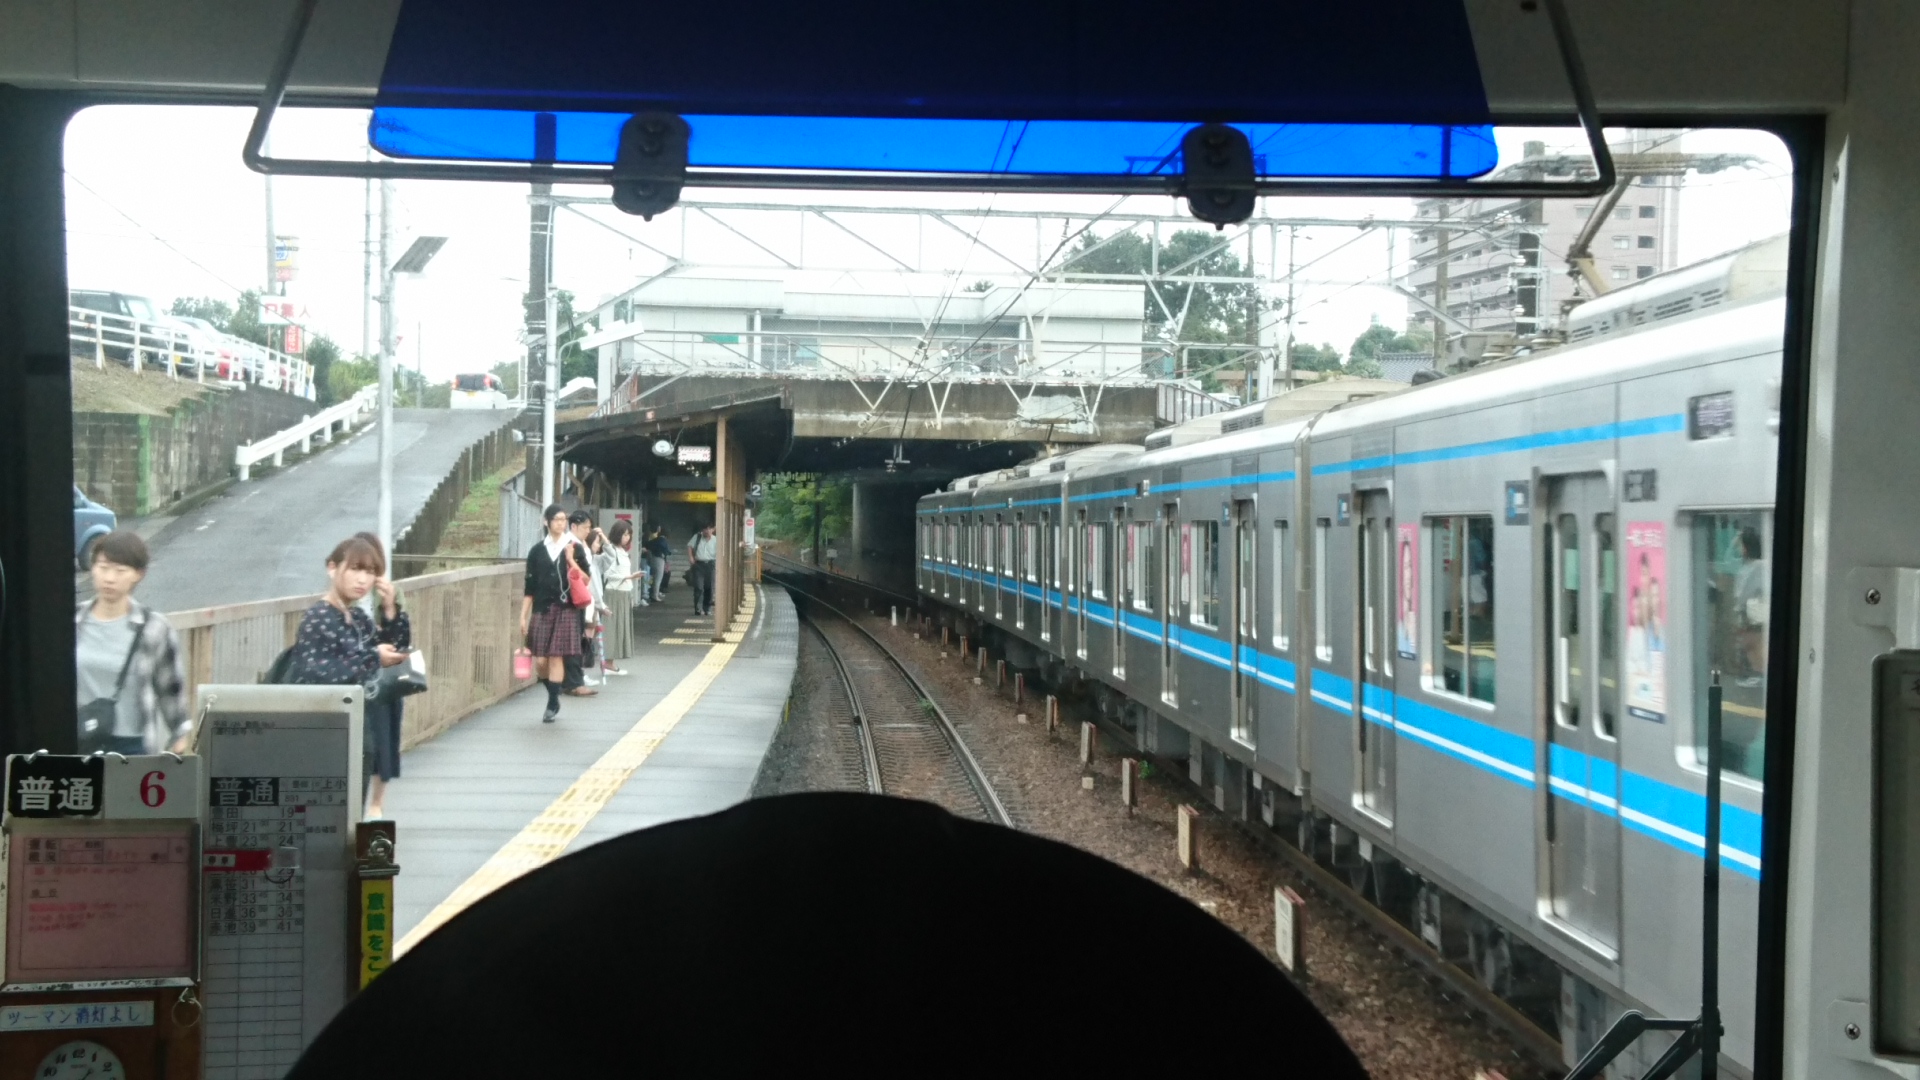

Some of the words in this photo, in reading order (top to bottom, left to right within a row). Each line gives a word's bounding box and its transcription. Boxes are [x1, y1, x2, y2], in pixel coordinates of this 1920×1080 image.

[752, 484, 761, 496] 2
[17, 775, 94, 811] 普通
[140, 771, 166, 807] 6
[214, 777, 275, 806] 普通
[281, 807, 294, 818] 19
[242, 822, 256, 833] 21
[279, 821, 292, 833] 21
[242, 836, 257, 847] 23
[278, 835, 294, 847] 24
[241, 879, 255, 890] 31
[241, 893, 256, 904] 33
[278, 892, 292, 903] 34
[241, 907, 256, 918] 36
[241, 921, 256, 933] 39
[277, 920, 291, 931] 41
[367, 893, 386, 982] 意識をこ
[8, 1006, 140, 1025] ツーマン消灯よし
[72, 1048, 85, 1058] 12
[92, 1051, 97, 1062] 1
[43, 1066, 57, 1077] 10
[103, 1062, 112, 1072] 2
